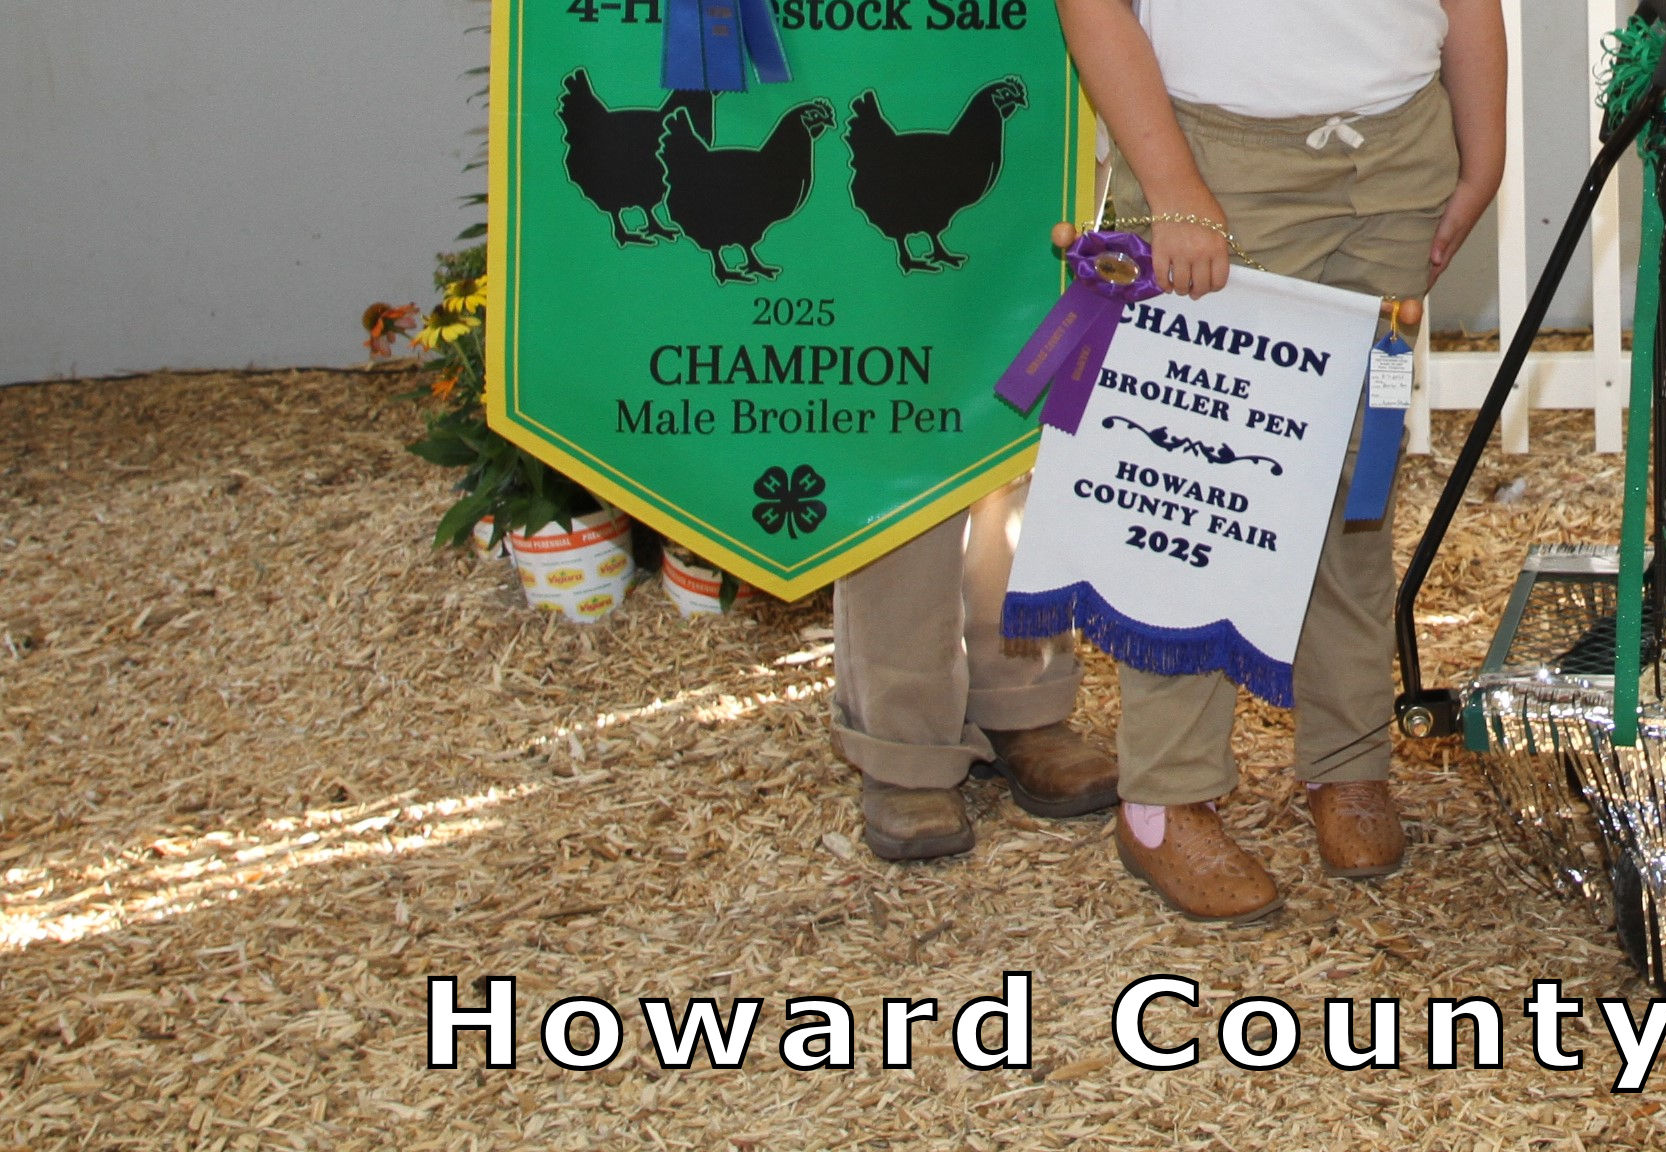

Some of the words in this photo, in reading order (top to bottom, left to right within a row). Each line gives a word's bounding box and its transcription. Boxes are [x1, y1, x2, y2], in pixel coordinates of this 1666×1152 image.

[752, 297, 836, 327] 2025
[1118, 302, 1331, 377] CHAMPION
[649, 345, 933, 386] CHAMPION
[1165, 360, 1250, 400] MALE
[615, 399, 715, 435] Male
[731, 398, 875, 435] Broiler
[889, 400, 963, 433] Pen
[1098, 367, 1231, 422] BROILER
[1246, 408, 1308, 441] PEN
[1115, 460, 1249, 513] HOWARD
[1074, 478, 1199, 527] COUNTY
[1207, 514, 1277, 552] FAIR
[1125, 525, 1212, 568] 2025
